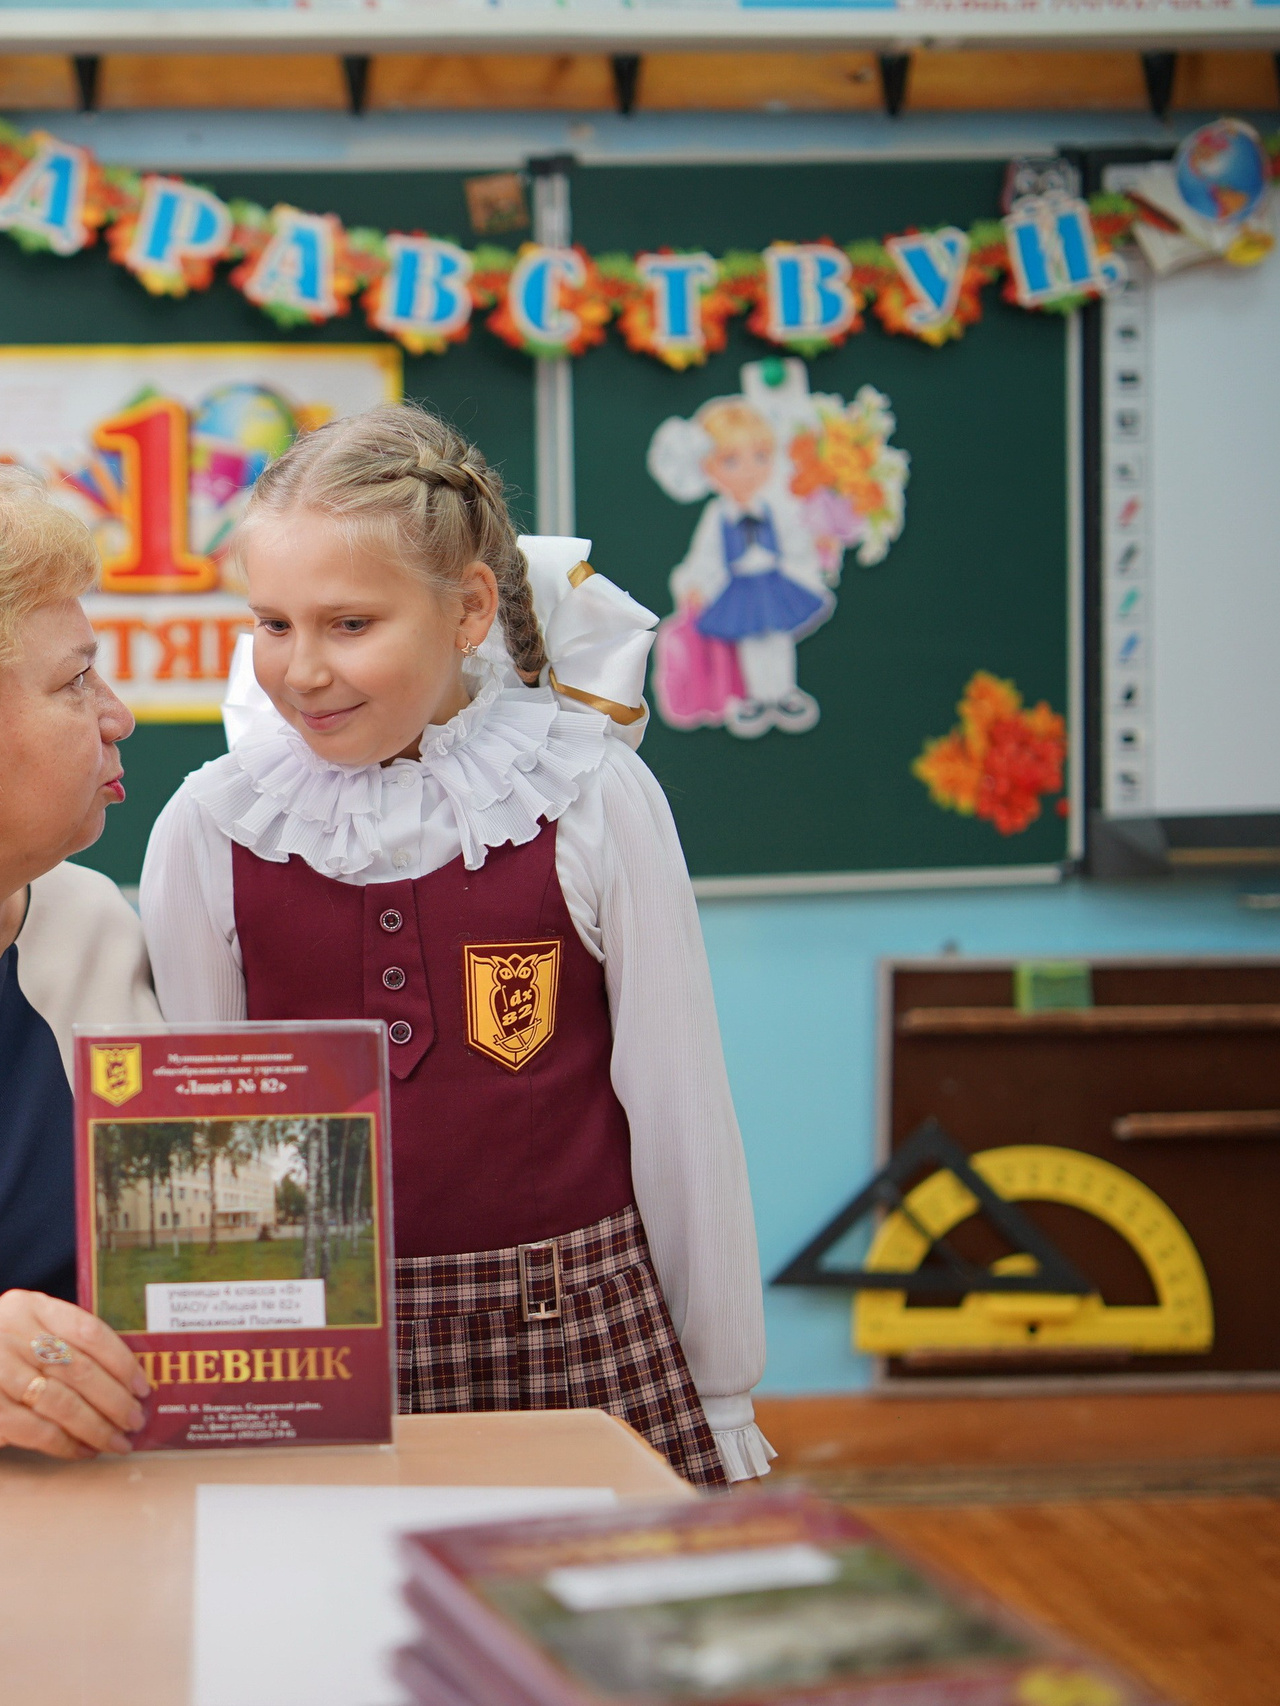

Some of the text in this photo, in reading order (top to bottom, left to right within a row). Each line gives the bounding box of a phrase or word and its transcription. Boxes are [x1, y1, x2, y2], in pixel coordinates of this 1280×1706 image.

[93, 397, 218, 593] 1
[501, 1003, 533, 1027] 82
[175, 1077, 287, 1095] «Лицей № 82»
[235, 1285, 276, 1296] класса
[170, 1302, 209, 1312] МАОУ
